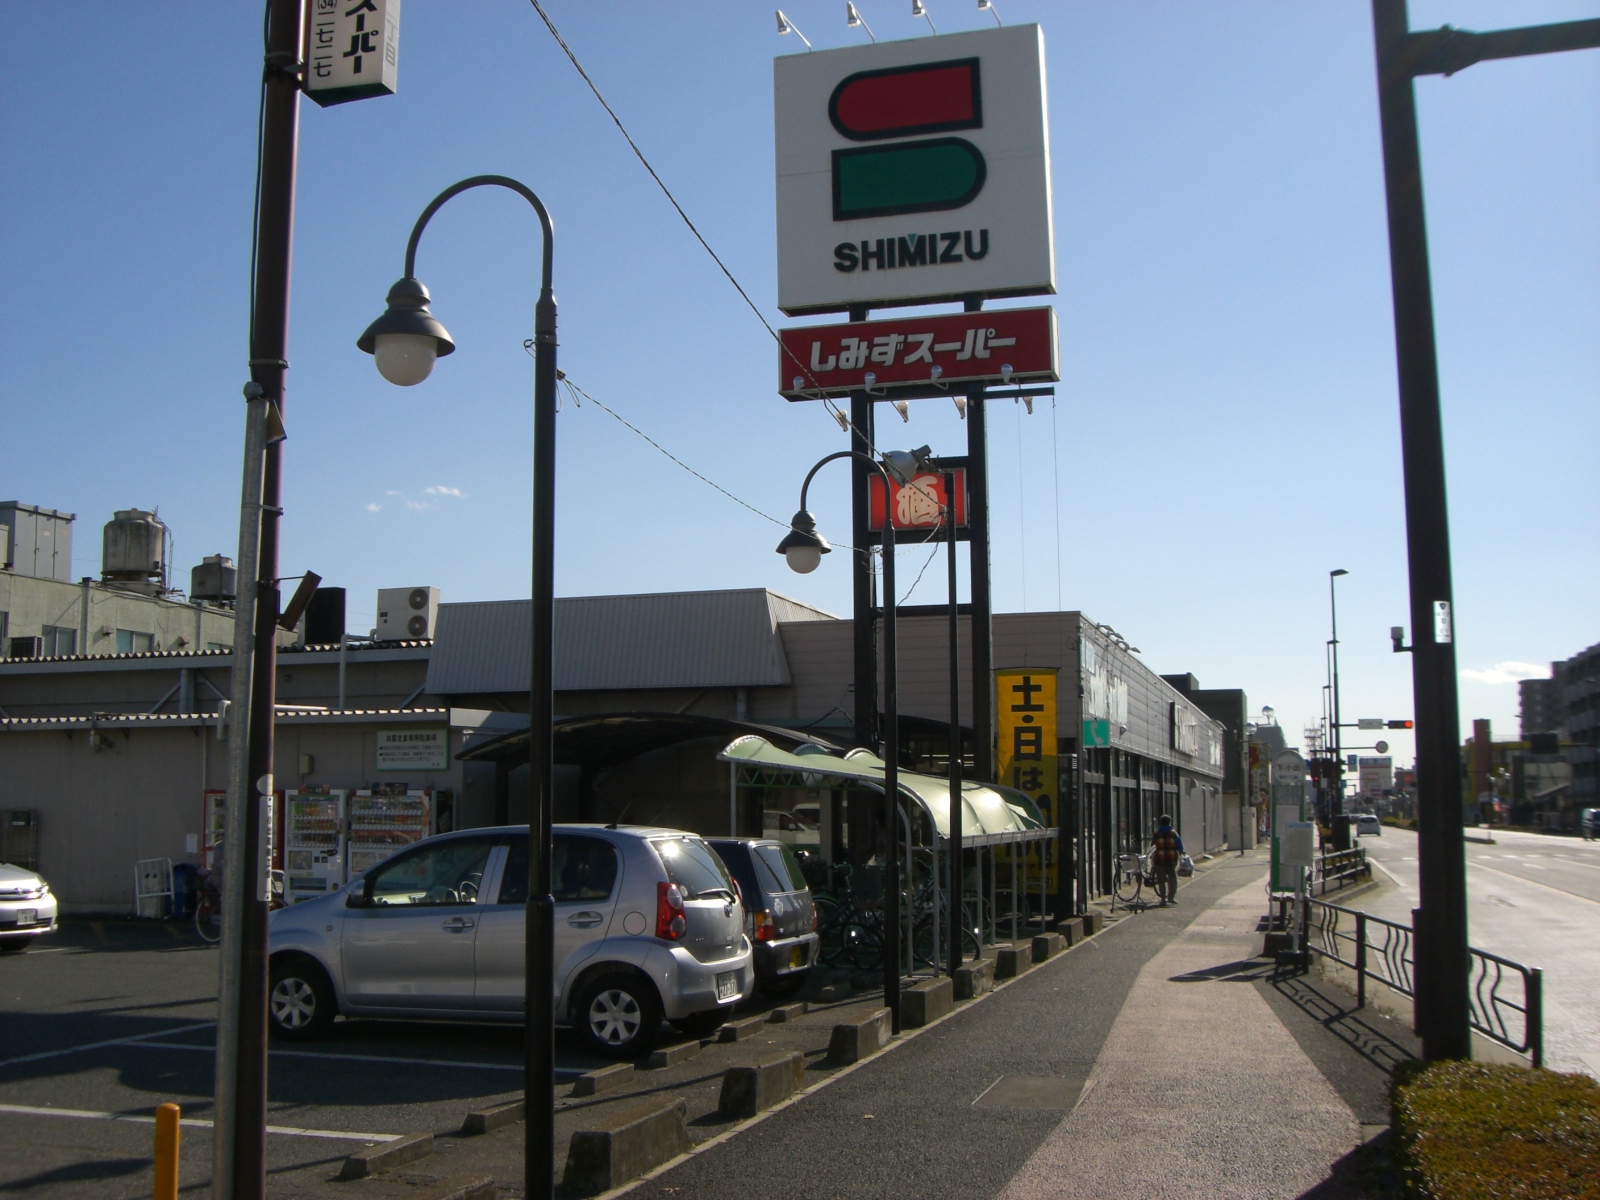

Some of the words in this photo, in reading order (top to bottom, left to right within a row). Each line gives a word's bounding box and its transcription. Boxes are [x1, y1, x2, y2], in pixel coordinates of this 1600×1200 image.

[833, 228, 989, 273] SHIMIZU
[809, 327, 1017, 373] しみずスーパー
